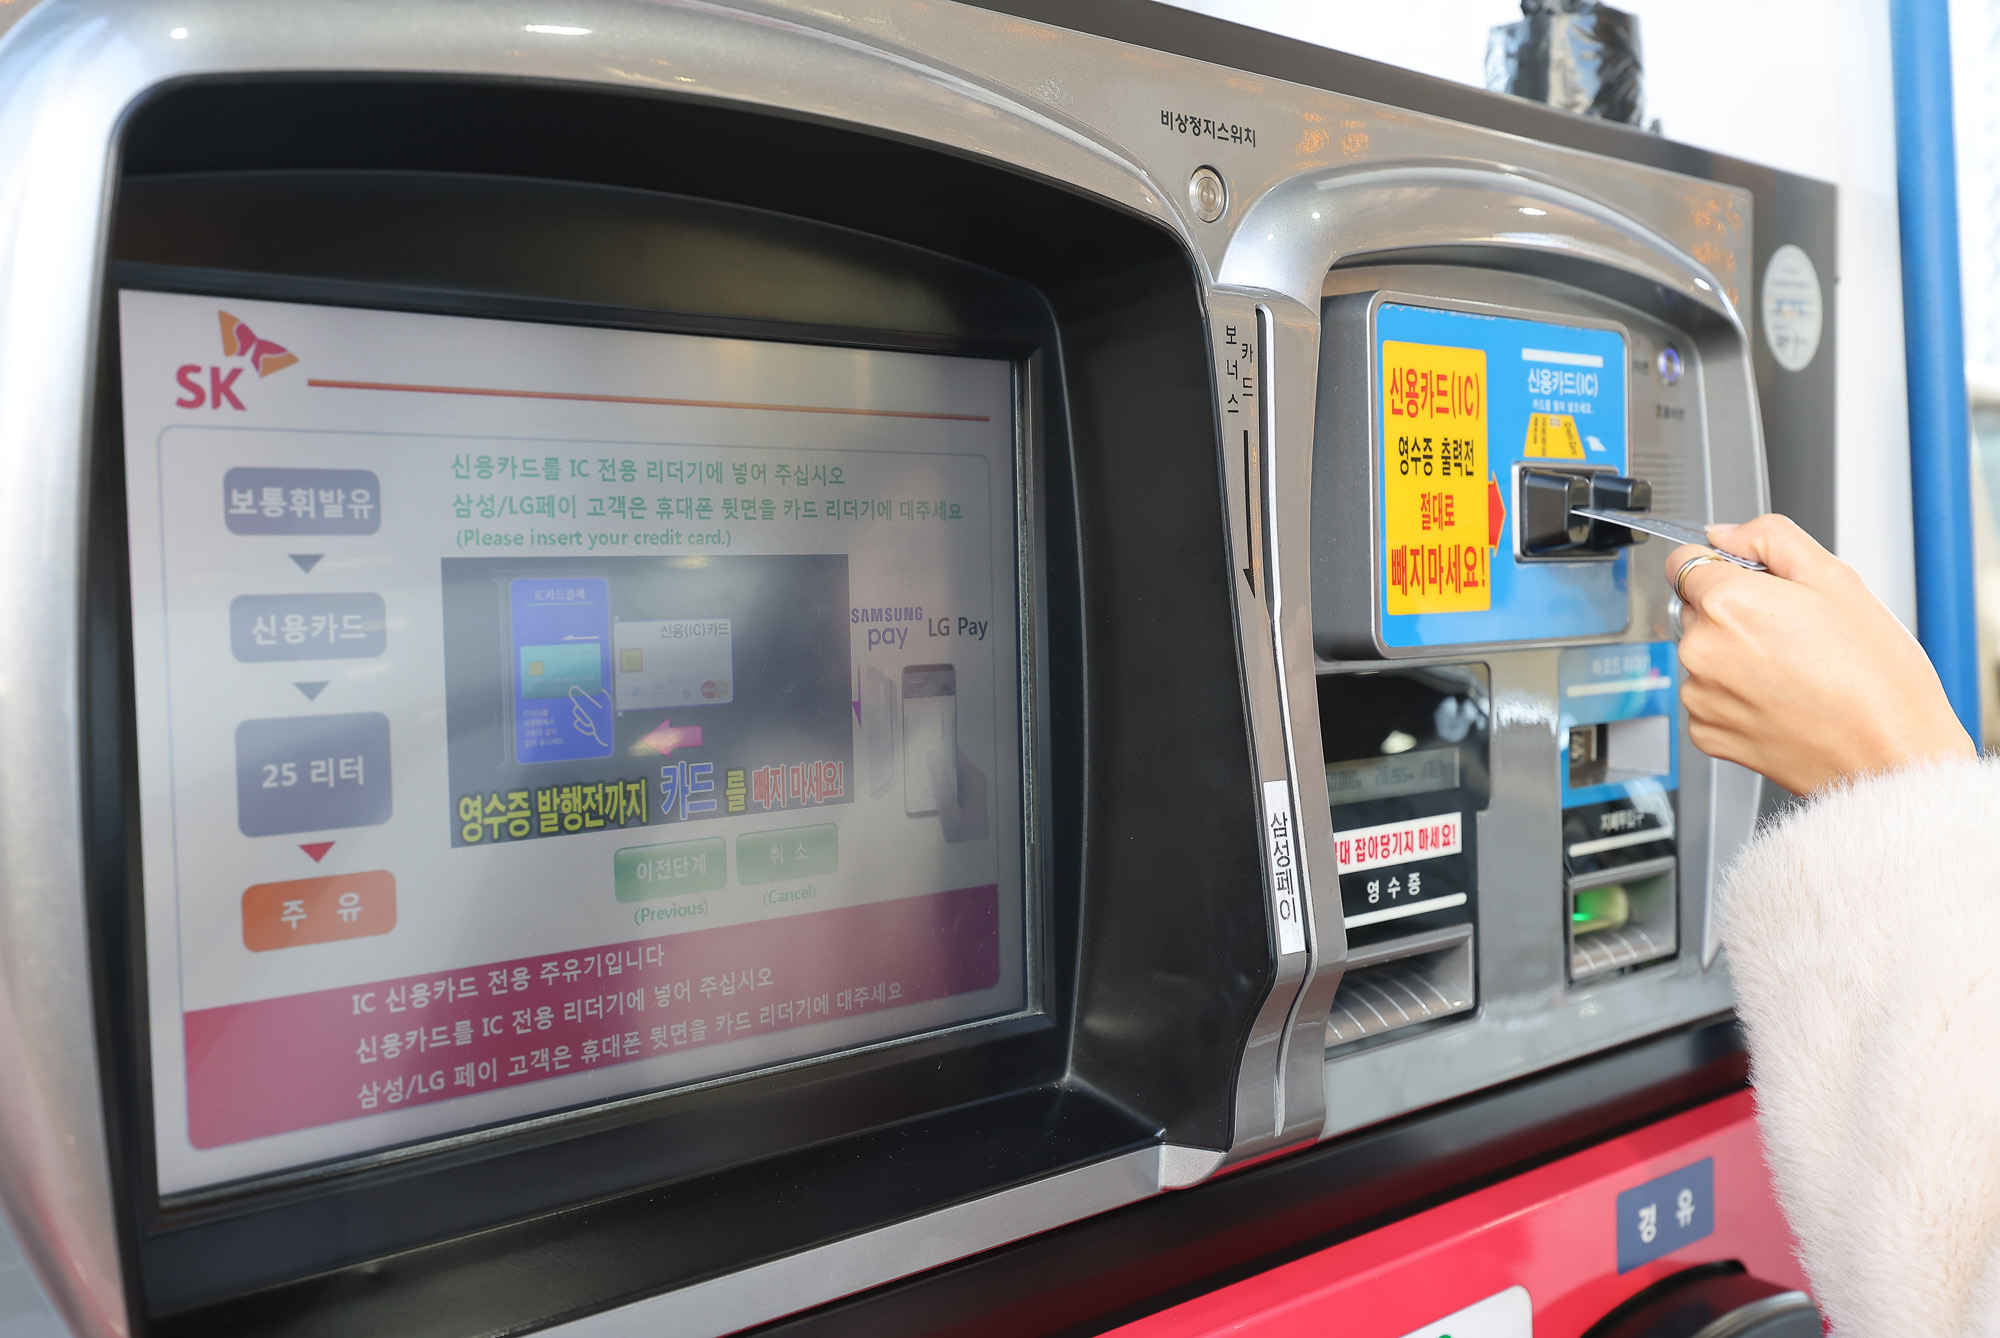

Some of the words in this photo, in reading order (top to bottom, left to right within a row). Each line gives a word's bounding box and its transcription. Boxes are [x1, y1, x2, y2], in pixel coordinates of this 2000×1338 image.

[1161, 110, 1256, 148] 비상정지스위치
[1226, 325, 1239, 413] 보너스
[1241, 343, 1254, 396] 카드
[1528, 368, 1599, 398] 신용카드(IC)
[175, 364, 247, 411] SK
[1390, 367, 1480, 420] 신용카드(IC)
[451, 454, 562, 481] 신용카드를
[569, 459, 590, 478] IC
[598, 458, 638, 483] 전용
[646, 459, 723, 485] 리더기에
[732, 462, 767, 486] 넣어
[775, 464, 845, 486] 주십시오
[1398, 435, 1433, 477] 영수증
[1440, 437, 1475, 477] 출력전
[228, 486, 375, 520] 보통휘발유
[452, 493, 577, 519] 삼성/LG페이
[586, 495, 647, 520] 고객은
[655, 496, 714, 520] 휴대폰
[721, 497, 776, 520] 뒷면을
[784, 499, 818, 520] 카드
[826, 499, 893, 521] 리더기에
[900, 500, 962, 521] 대주세요
[1420, 491, 1455, 531] 절대로
[456, 529, 524, 548] (Please
[530, 529, 582, 546] insert
[588, 532, 629, 550] your
[634, 529, 683, 546] credit
[687, 529, 732, 548] card.)
[1391, 544, 1486, 597] 빼지마세요!
[251, 612, 367, 645] 신용카드
[660, 622, 730, 639] 신용(IC)카드
[851, 606, 923, 624] SAMSUNG
[928, 617, 950, 638] LG
[958, 617, 988, 640] Pay
[868, 626, 909, 650] pay
[261, 763, 298, 788] 25
[310, 755, 365, 788] 리터
[458, 791, 531, 843] 영수증
[537, 778, 648, 834] 발행전까지
[660, 761, 718, 820] 카드
[725, 770, 747, 813] 를
[752, 765, 786, 809] 빼지
[790, 761, 844, 806] 마세요!
[1334, 840, 1350, 865] 대
[1355, 830, 1414, 863] 잡아당기지
[1419, 824, 1456, 851] 마세요!
[637, 852, 707, 883] 이전단계
[1270, 812, 1297, 923] 삼성페이
[634, 899, 709, 926] (Previous)
[762, 883, 816, 907] (Cancel)
[352, 992, 376, 1015] IC
[385, 977, 478, 1013] 신용카드
[488, 966, 531, 996] 전용
[540, 944, 665, 986] 주유기입니다
[355, 1020, 474, 1064] 신용카드를
[482, 1015, 504, 1037] IC
[512, 1005, 554, 1035] 전용
[564, 988, 645, 1023] 리더기에
[654, 979, 691, 1008] 넣어
[700, 967, 774, 999] 주십시오
[357, 1070, 445, 1110] 삼성/LG
[454, 1058, 498, 1088] 페이
[507, 1045, 572, 1077] 고객은
[581, 1031, 642, 1064] 휴대폰
[650, 1018, 708, 1051] 뒷면을
[716, 1011, 752, 1036] 카드
[759, 993, 829, 1026] 리더기에
[837, 982, 903, 1011] 대주세요
